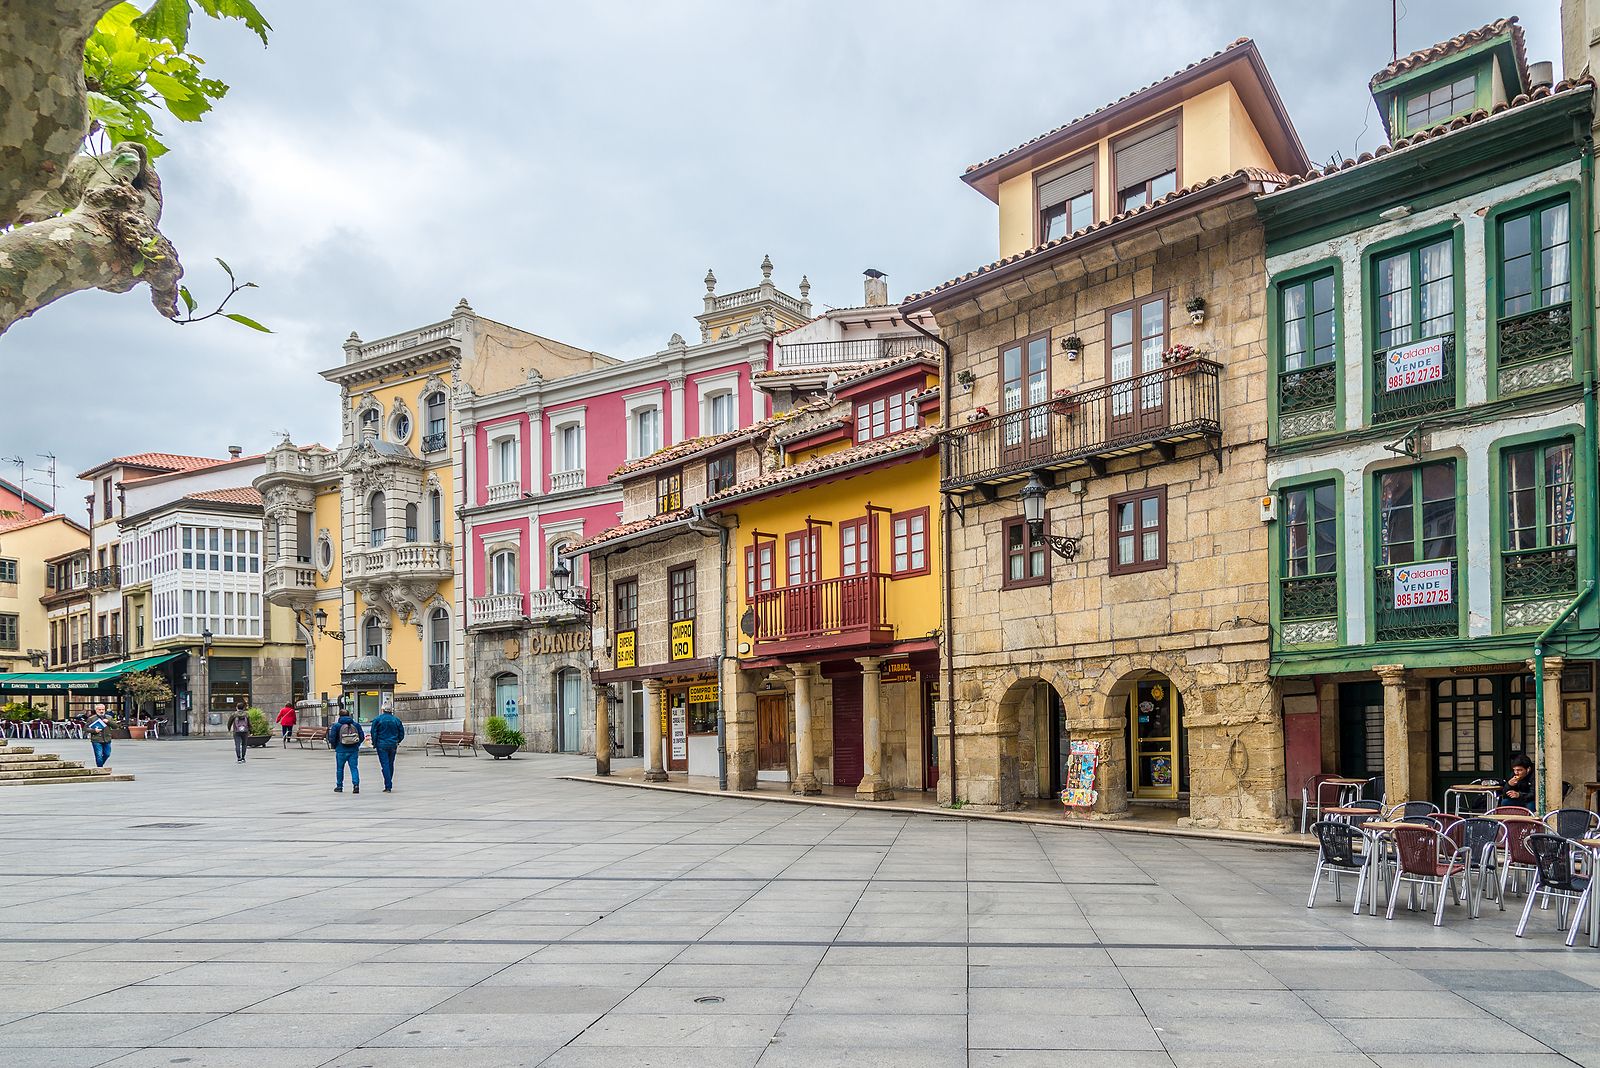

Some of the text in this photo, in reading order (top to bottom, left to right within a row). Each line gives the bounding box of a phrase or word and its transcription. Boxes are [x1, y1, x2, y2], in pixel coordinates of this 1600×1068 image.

[1402, 345, 1440, 360] aldama
[1395, 358, 1432, 373] VENDE
[1388, 365, 1440, 389] 985 52 27 25
[1410, 568, 1449, 579] aldama
[1403, 581, 1440, 592] VENDE
[1397, 589, 1449, 607] 985 52 27 25
[672, 624, 691, 640] COMPRO
[674, 641, 689, 657] ORO
[690, 687, 711, 695] COMPRO
[690, 694, 703, 702] TODO
